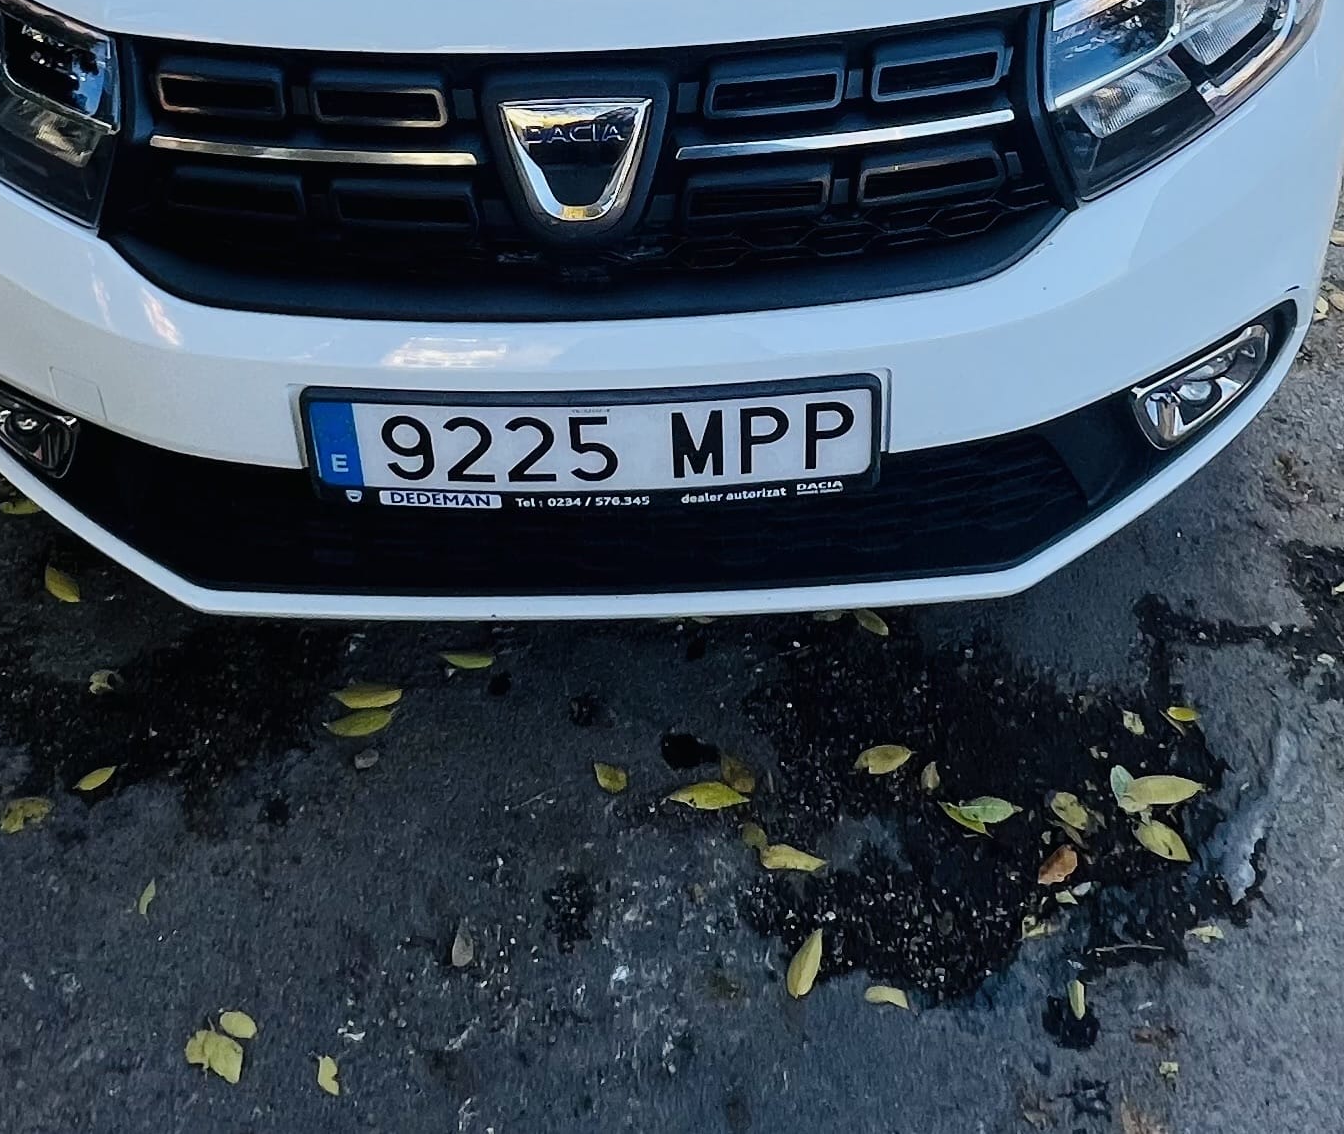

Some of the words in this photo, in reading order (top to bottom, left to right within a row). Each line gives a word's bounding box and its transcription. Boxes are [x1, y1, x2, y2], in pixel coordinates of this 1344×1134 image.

[524, 123, 625, 144] DACIA
[380, 414, 619, 483] 9225
[670, 401, 856, 479] MPP
[331, 453, 348, 473] E
[796, 480, 843, 491] DACIA
[390, 491, 491, 507] DEDEMAN
[547, 497, 583, 507] 0234
[595, 495, 651, 507] 576.345
[681, 492, 723, 504] dealer
[726, 486, 788, 502] autorizat
